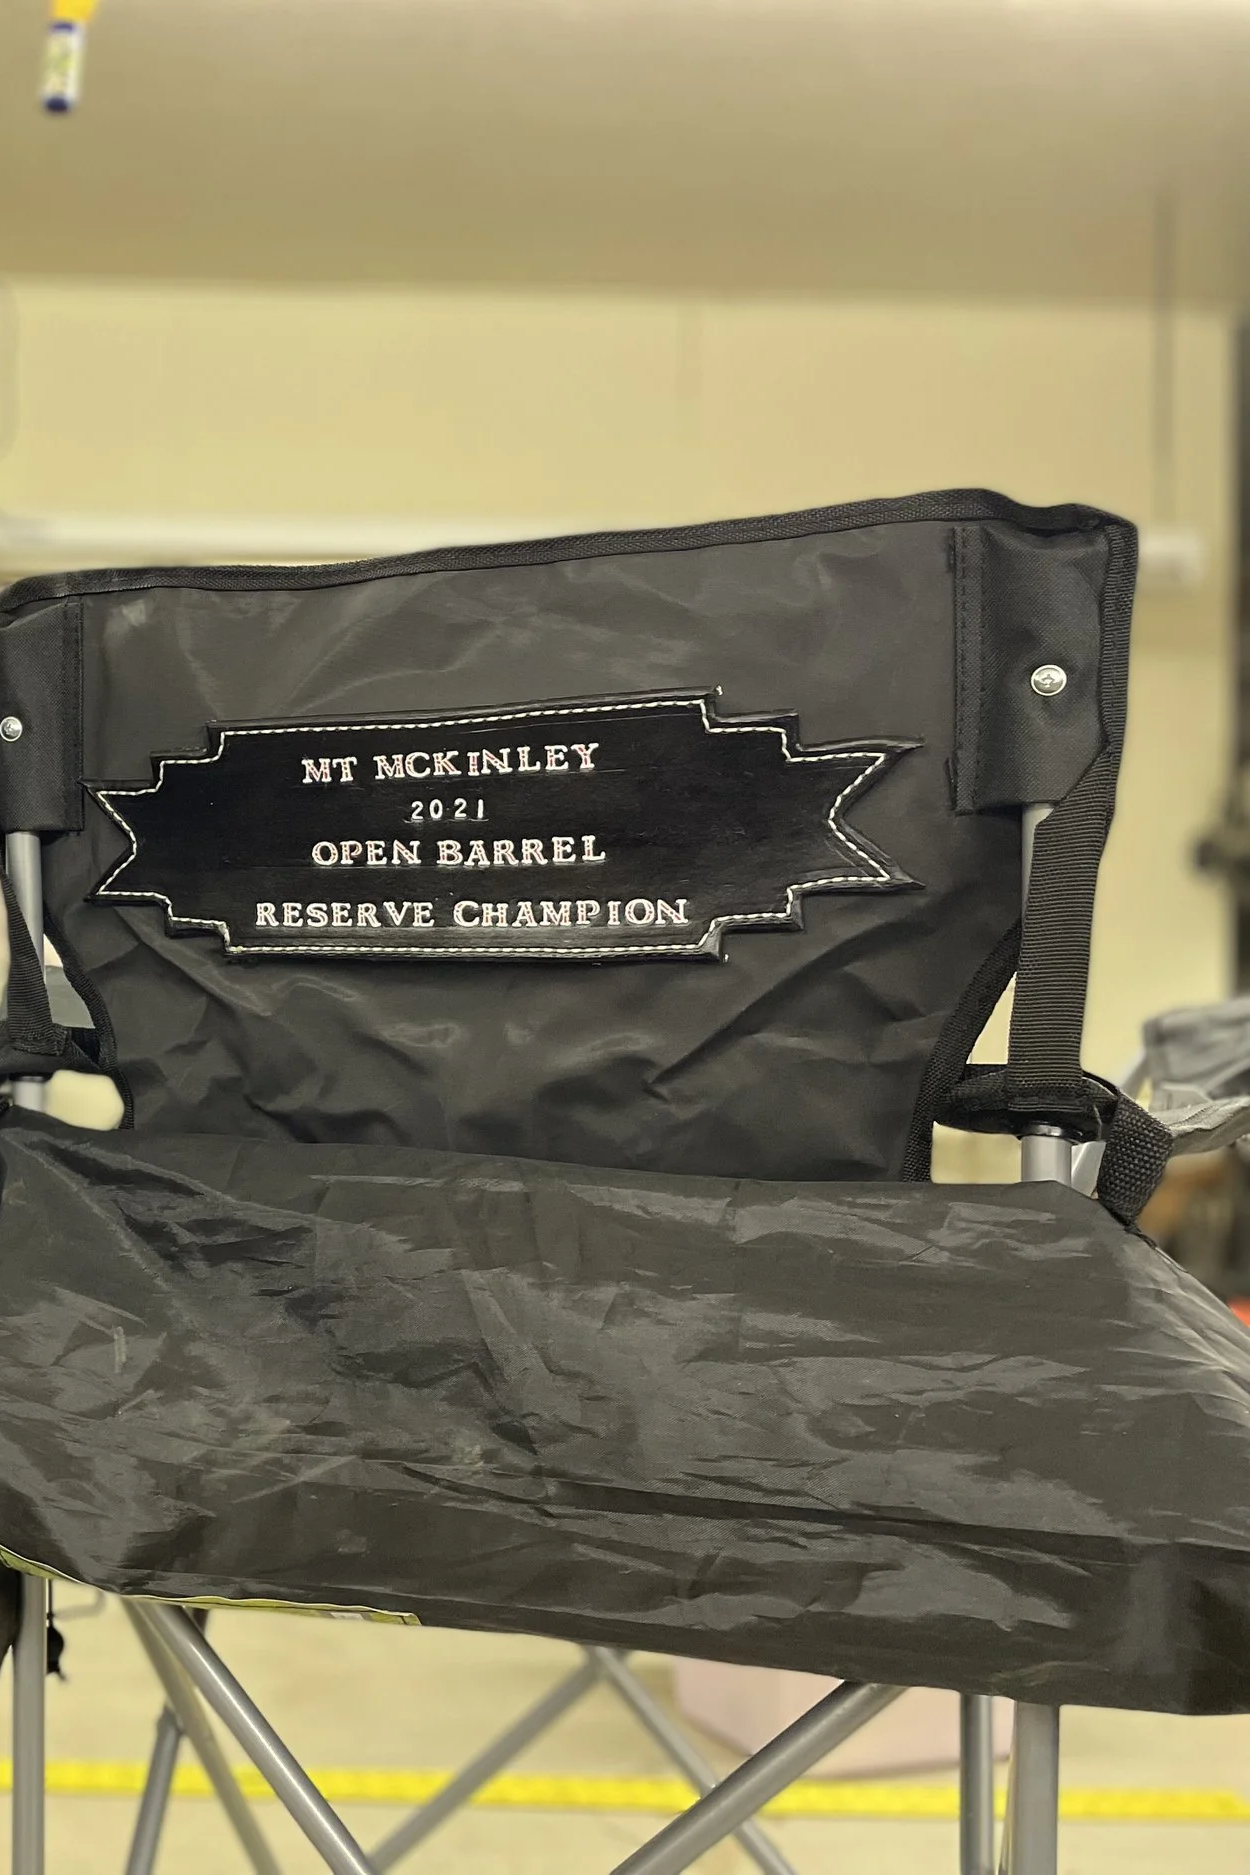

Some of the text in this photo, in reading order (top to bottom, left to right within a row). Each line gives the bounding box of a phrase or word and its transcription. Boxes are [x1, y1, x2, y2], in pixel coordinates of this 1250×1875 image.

[301, 742, 600, 784] MT MCKINLEY
[410, 798, 485, 820] 2021
[311, 834, 606, 866] OPEN BARREL
[255, 898, 689, 927] RESERVE CHAMPION
